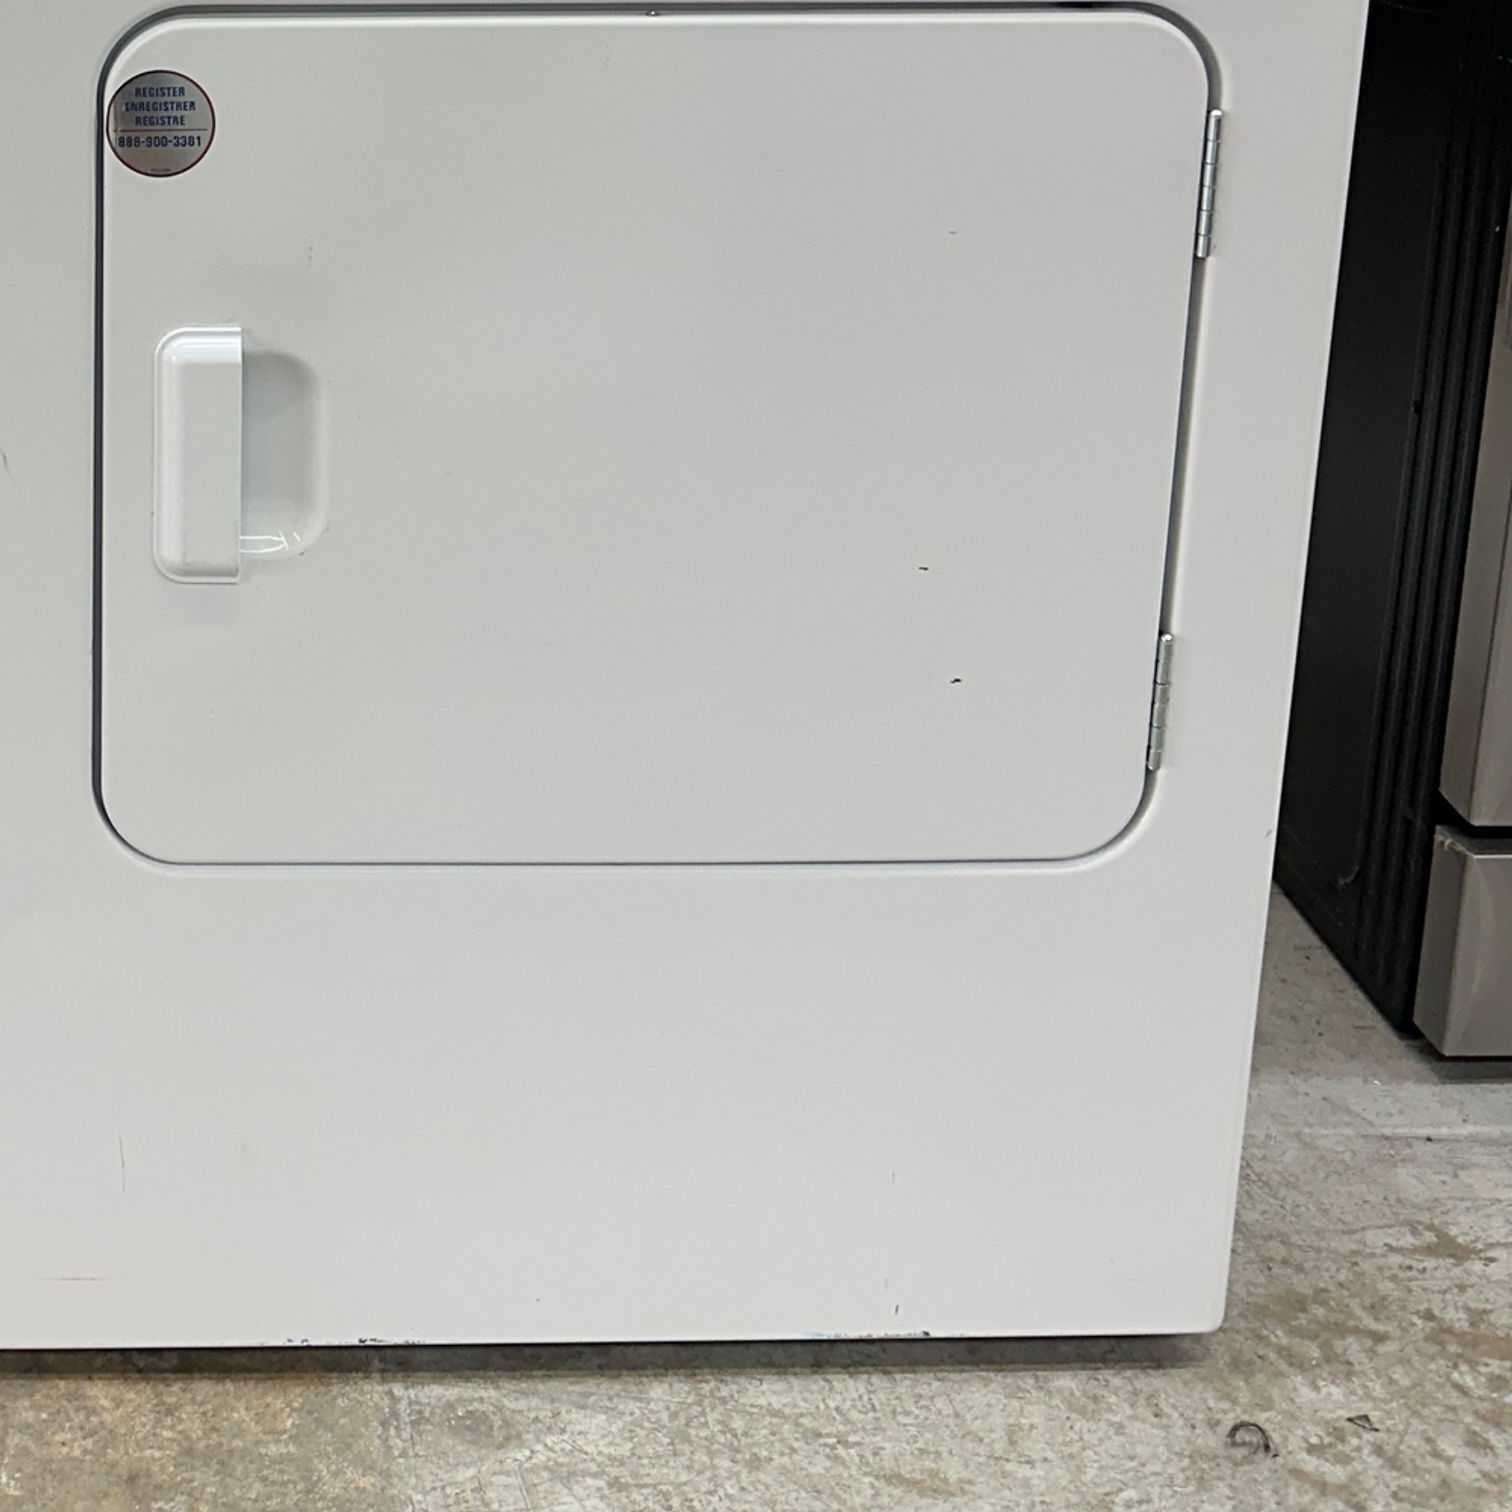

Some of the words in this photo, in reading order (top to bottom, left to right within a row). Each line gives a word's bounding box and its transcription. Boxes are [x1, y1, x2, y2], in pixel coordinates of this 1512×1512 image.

[134, 86, 186, 99] REGISTER
[124, 100, 197, 113] ENREGISTRER
[135, 115, 186, 127] REGISTRE
